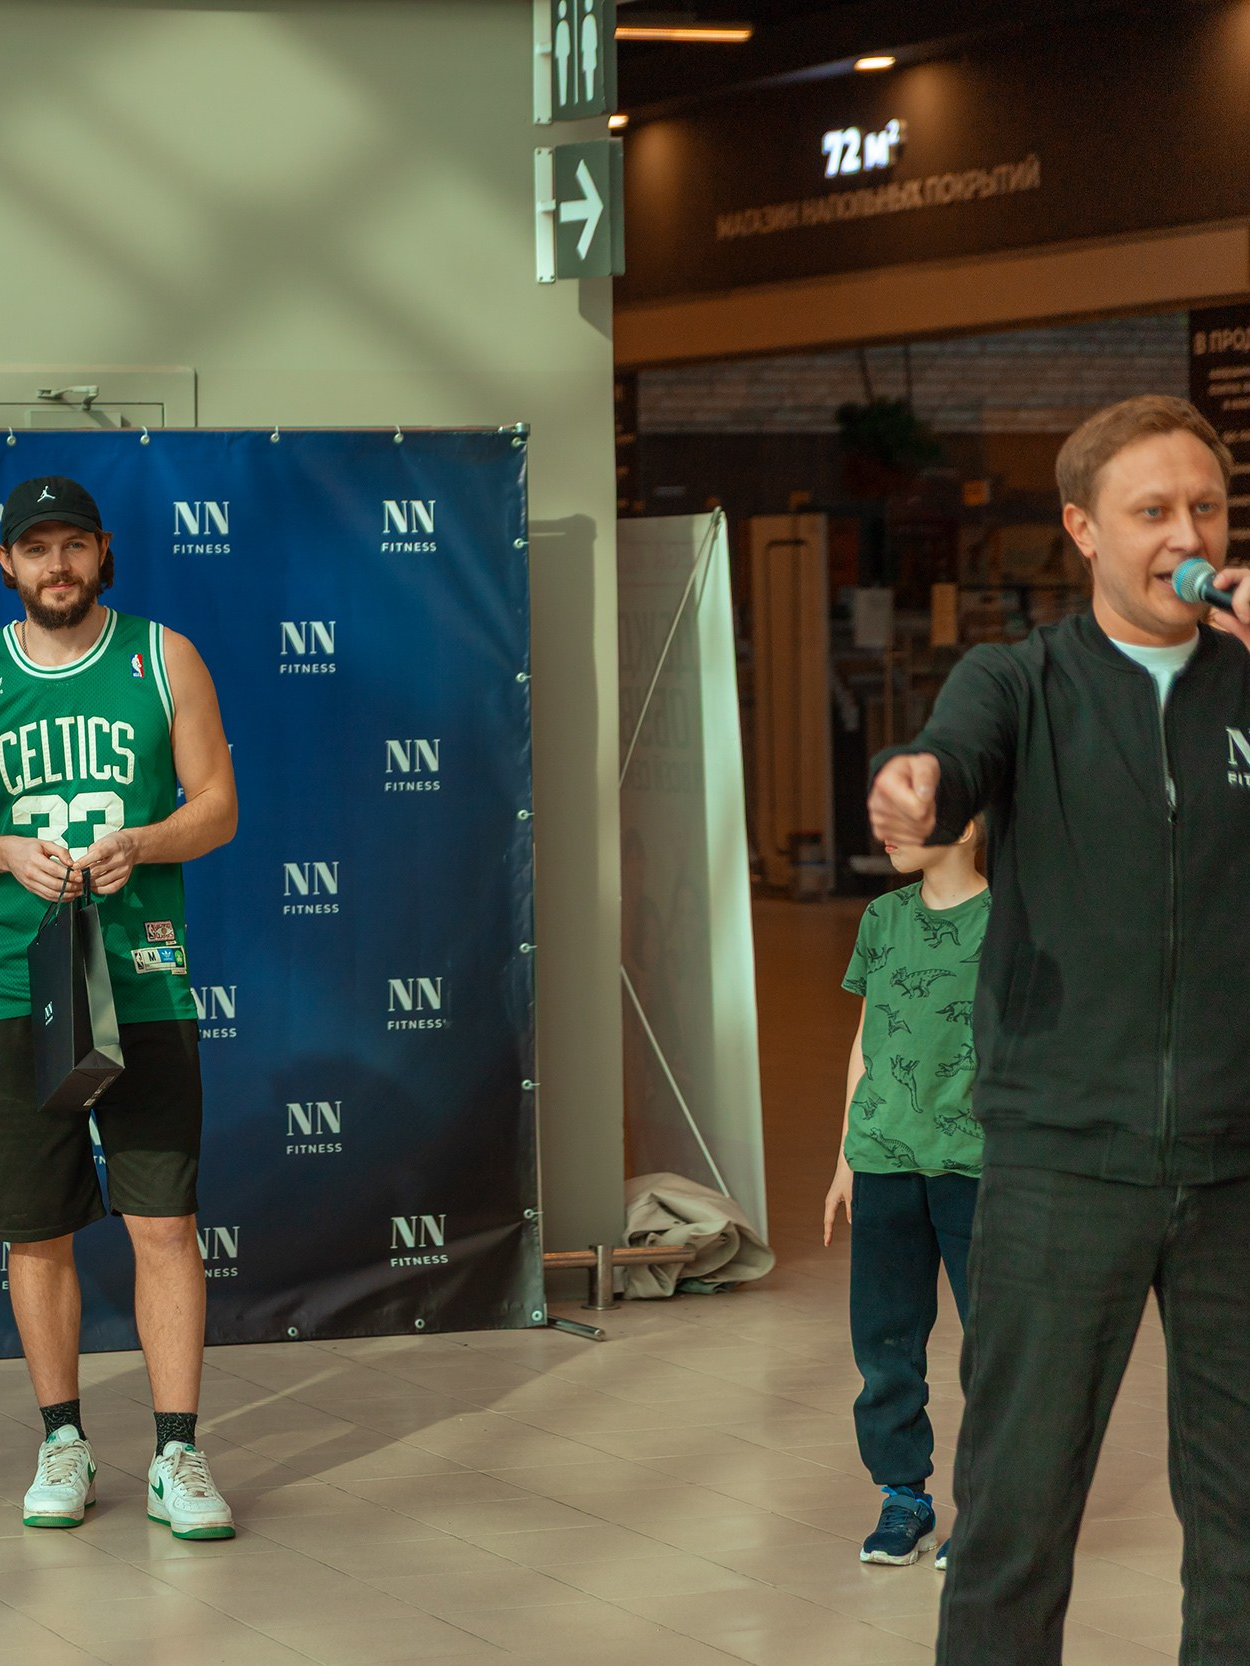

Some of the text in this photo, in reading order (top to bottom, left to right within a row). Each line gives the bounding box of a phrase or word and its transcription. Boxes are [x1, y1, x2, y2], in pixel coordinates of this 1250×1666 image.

[822, 127, 862, 178] 72
[174, 502, 230, 535] NN
[383, 500, 436, 533] NN
[174, 544, 231, 554] FITNESS
[382, 542, 437, 552] FITNESS
[281, 621, 336, 655] NN
[280, 664, 336, 674] FITNESS
[386, 739, 440, 773] NN
[385, 781, 441, 792] FITNESS
[12, 791, 125, 862] 33
[284, 861, 339, 895] NN
[283, 904, 340, 914] FITNESS
[389, 977, 443, 1011] NN
[203, 1028, 237, 1038] NESS
[388, 1019, 443, 1030] FITNESS
[287, 1101, 342, 1135] NN
[287, 1143, 343, 1154] FITNESS
[391, 1215, 446, 1248] NN
[391, 1255, 448, 1267] FITNESS
[205, 1268, 238, 1278] NESS
